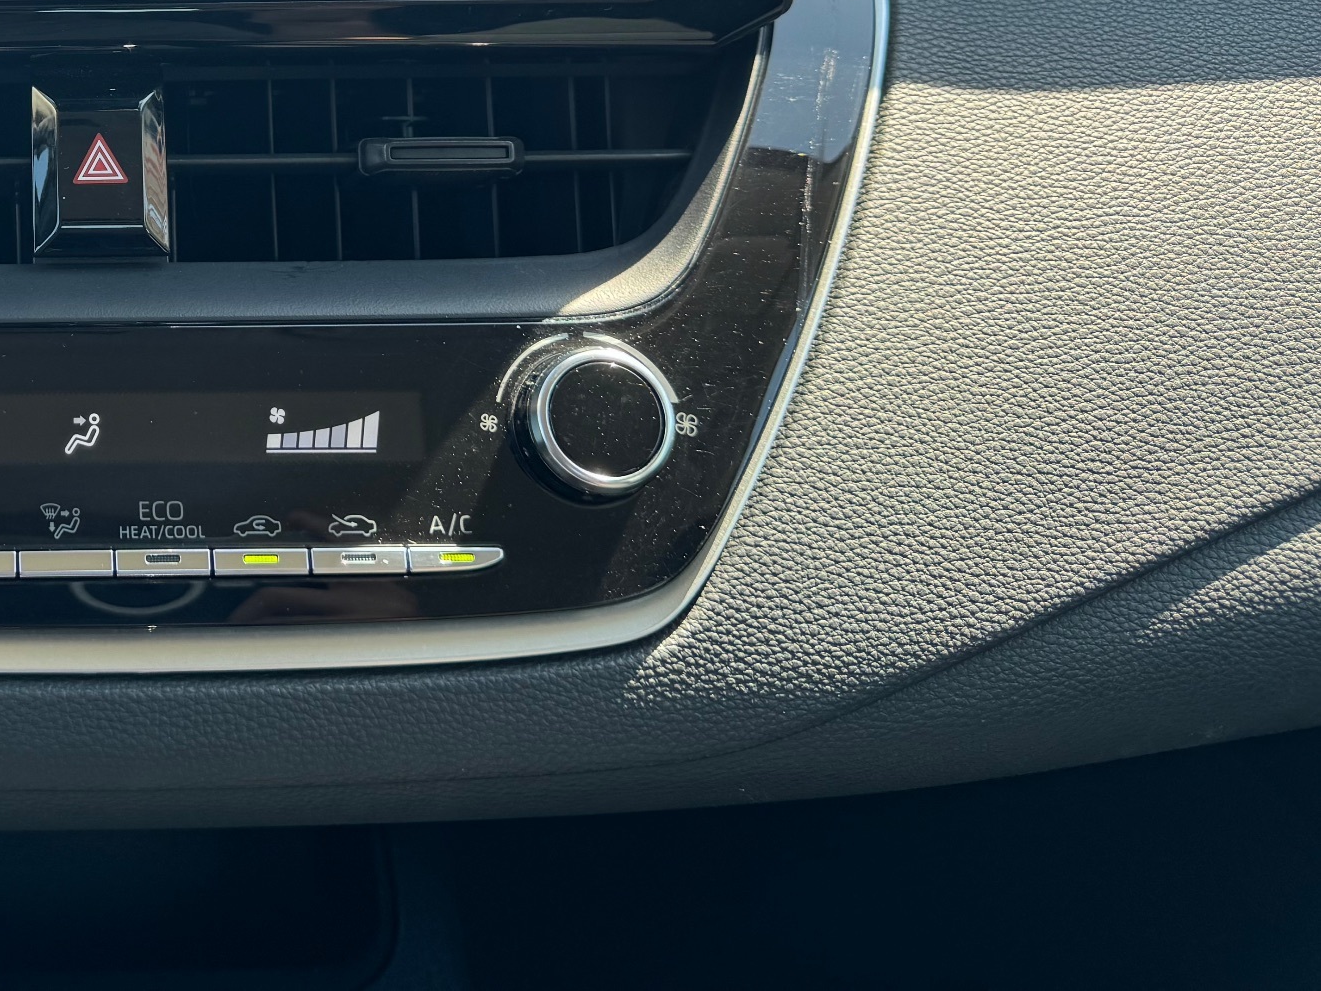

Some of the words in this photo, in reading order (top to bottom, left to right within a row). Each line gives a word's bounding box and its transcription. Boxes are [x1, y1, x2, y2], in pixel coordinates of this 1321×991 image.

[139, 501, 184, 521] ECO
[119, 524, 206, 540] HEAT/COOL
[429, 515, 472, 535] A/C
